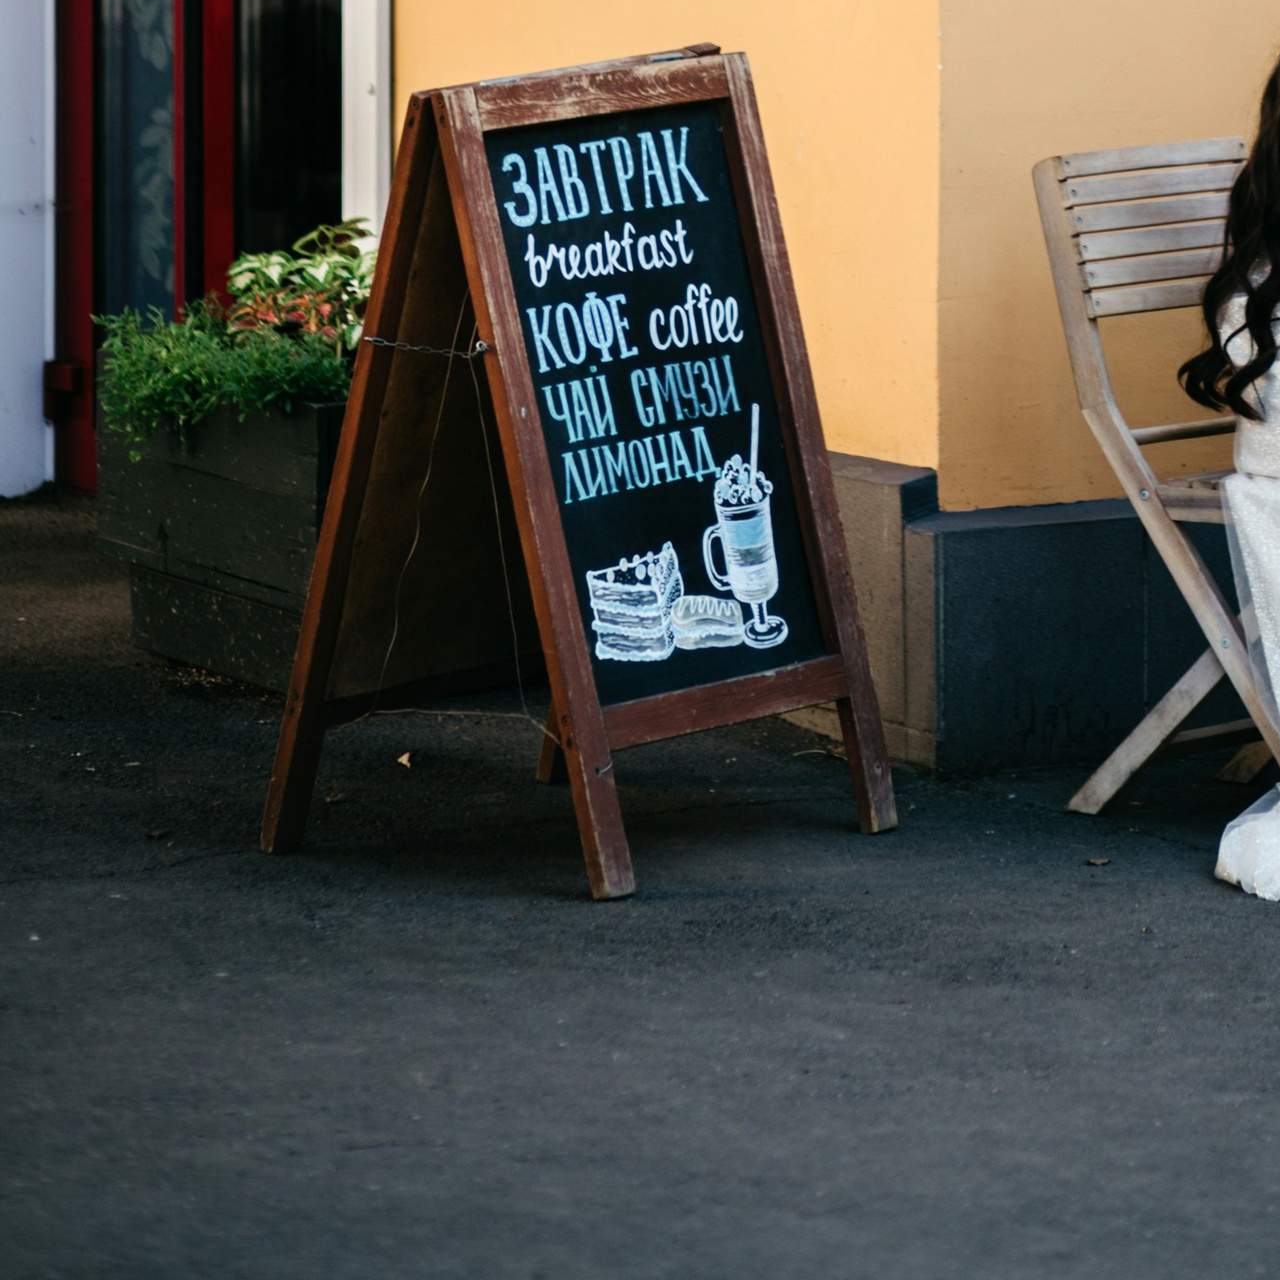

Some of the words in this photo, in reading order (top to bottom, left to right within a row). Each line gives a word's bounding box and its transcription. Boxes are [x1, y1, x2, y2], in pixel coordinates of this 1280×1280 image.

[502, 126, 709, 228] ЗАВТРАК
[524, 219, 694, 287] breakfast
[526, 291, 639, 373] КОФЕ
[649, 283, 744, 350] coffee
[541, 365, 618, 444] ЧАЙ
[630, 355, 741, 427] СМУЗИ
[562, 426, 721, 504] ЛИМОНАД
